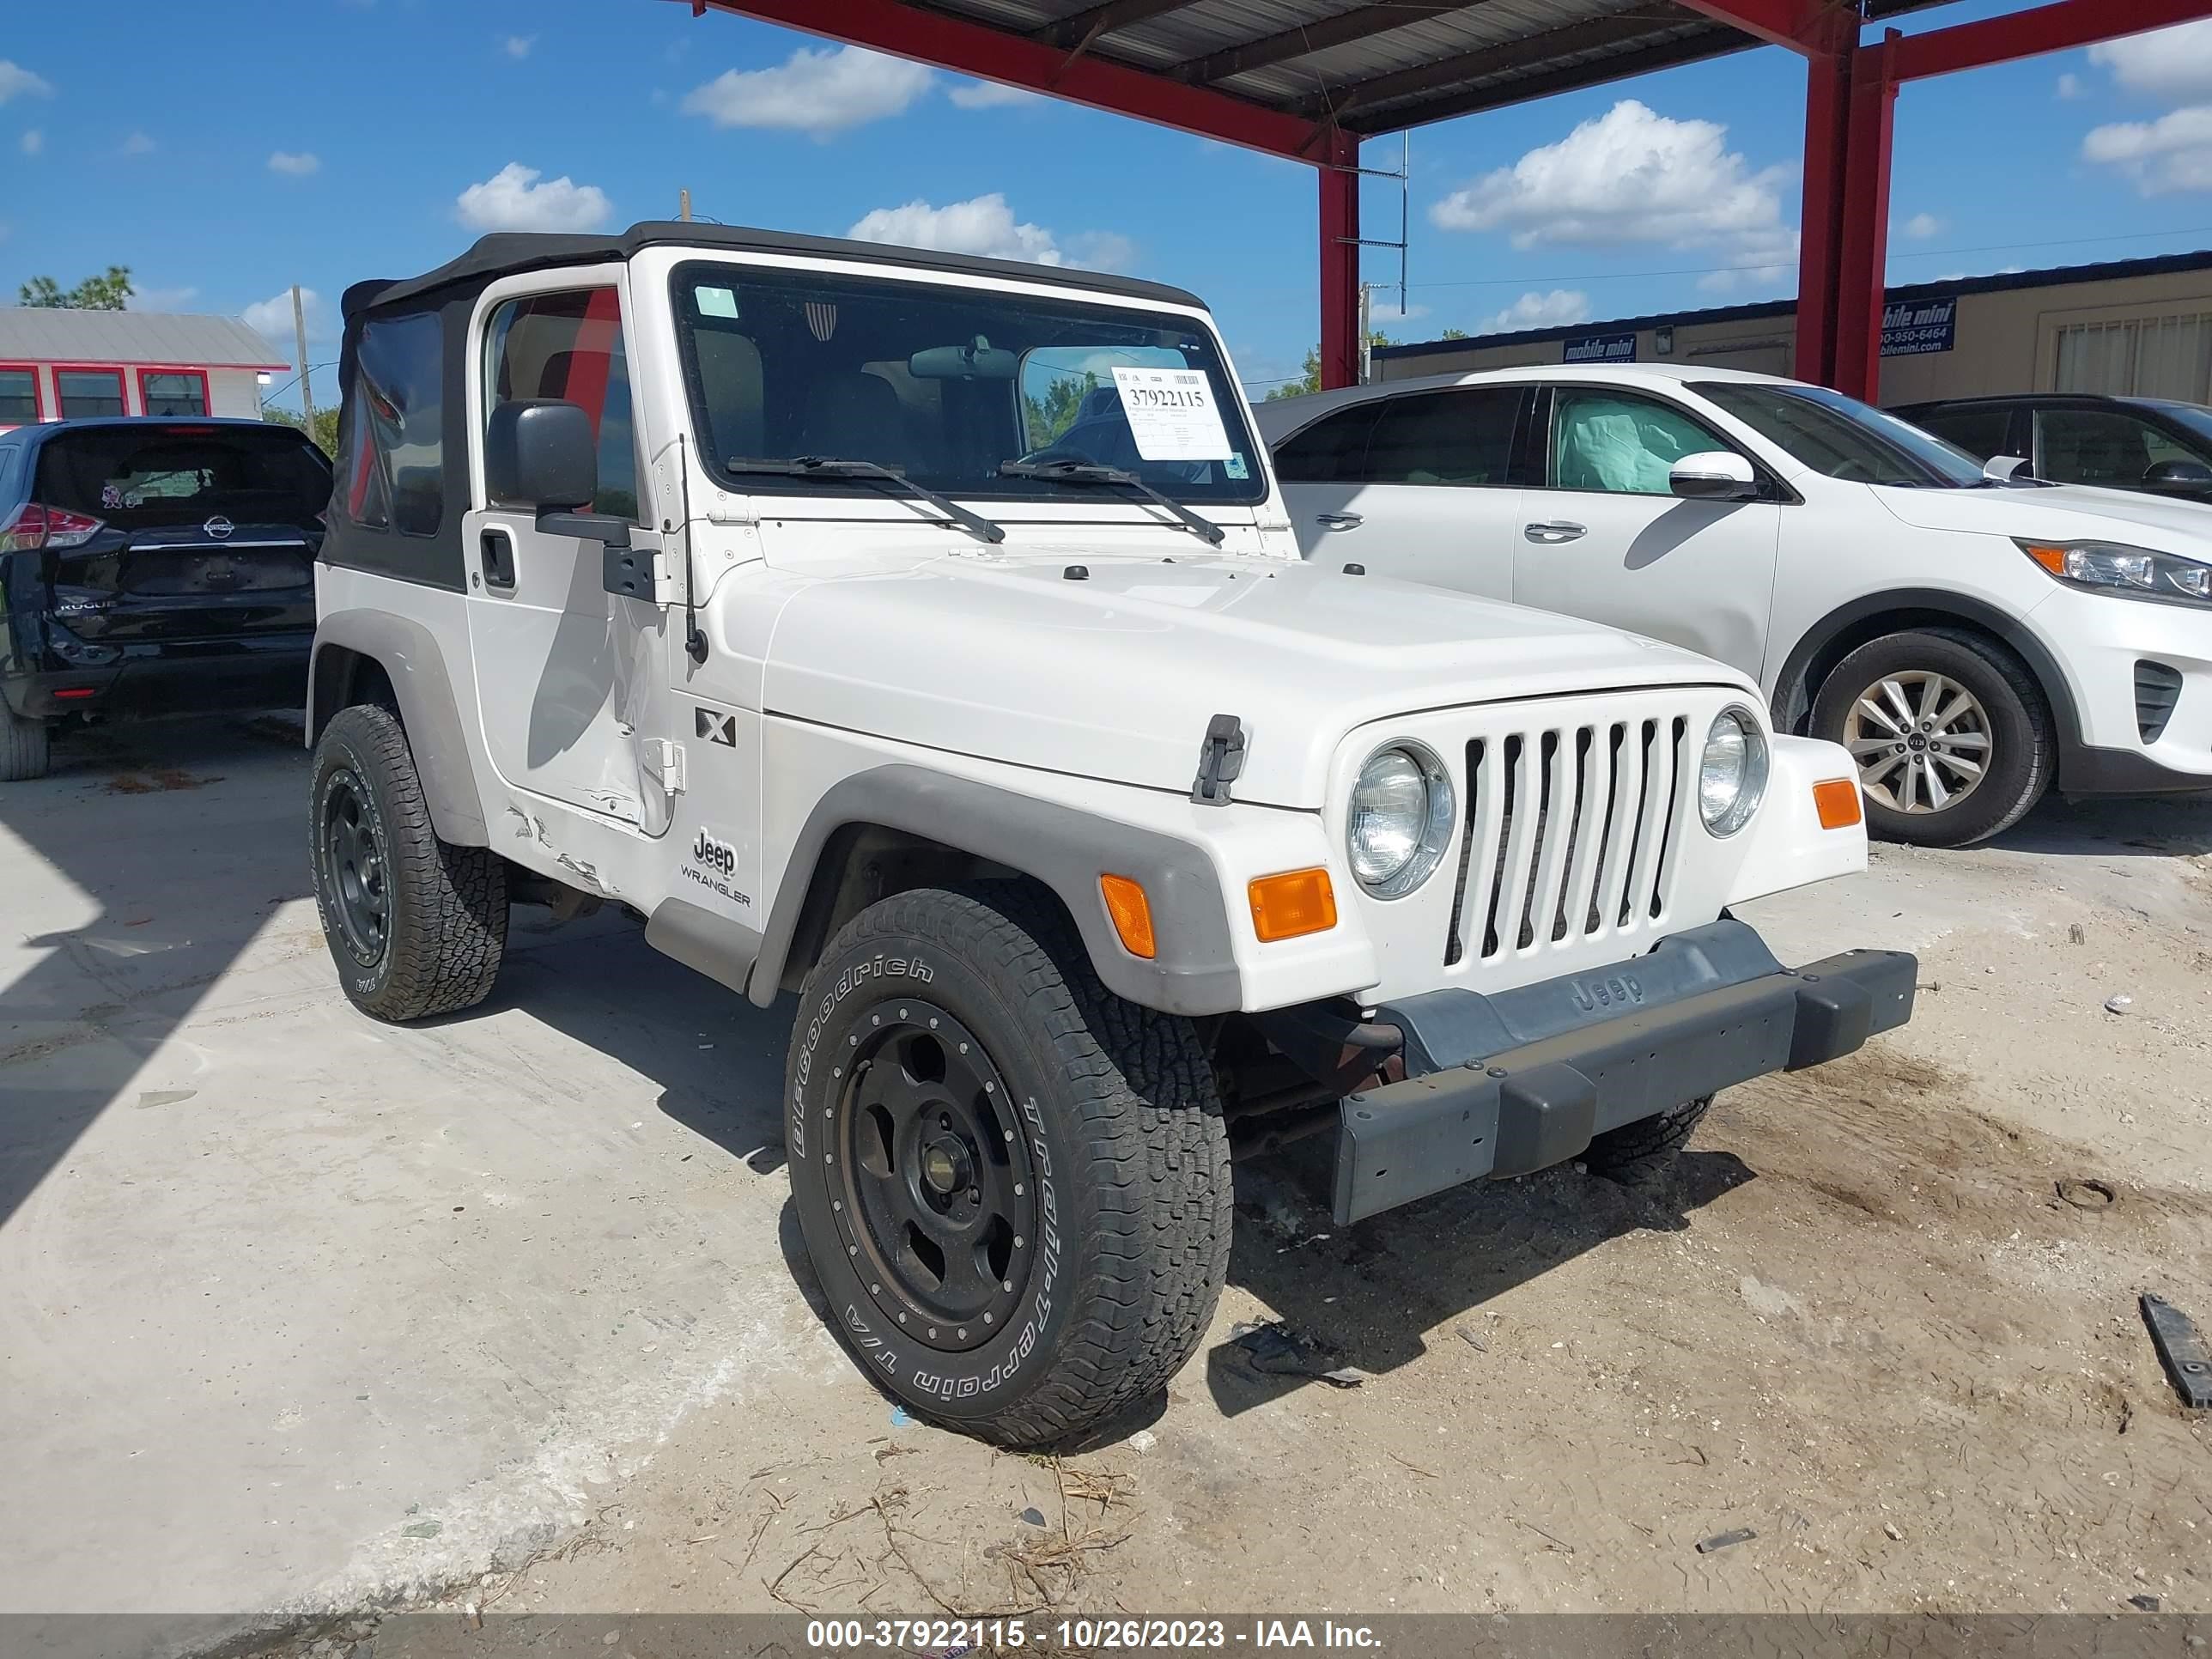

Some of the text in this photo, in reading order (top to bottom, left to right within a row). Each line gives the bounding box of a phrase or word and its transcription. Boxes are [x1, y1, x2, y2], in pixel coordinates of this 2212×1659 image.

[1881, 302, 1954, 329] bile mini
[1565, 337, 1635, 360] mobile mini
[1881, 327, 1948, 344] 0-950-6464
[1881, 341, 1942, 356] bilemini.com
[1129, 388, 1205, 408] 37922115
[60, 600, 118, 611] ROGUE
[702, 711, 734, 744] X
[693, 831, 734, 877] Jeep
[680, 863, 752, 908] WRANGLER
[356, 975, 378, 994] T/A
[1571, 975, 1644, 1012] Jeep
[792, 954, 935, 1159] BFGoodrich
[844, 1304, 899, 1375] T/A
